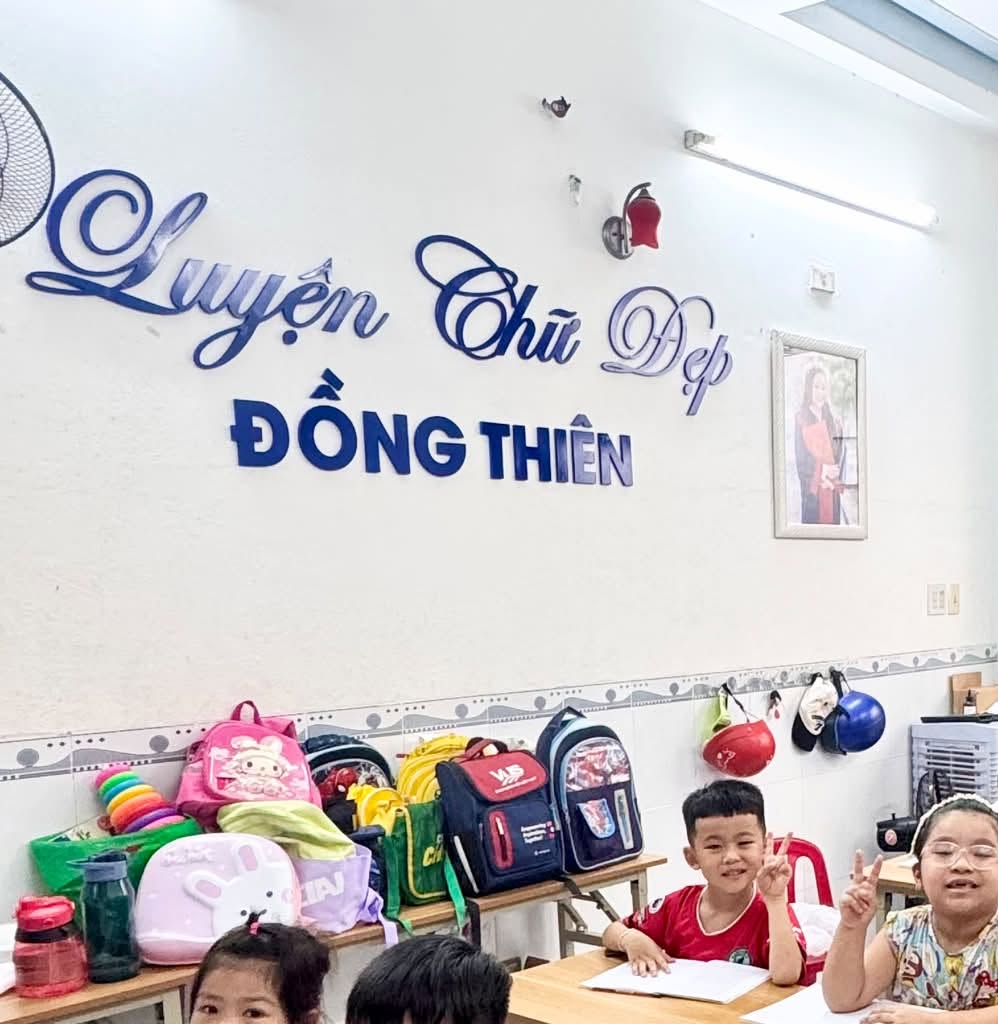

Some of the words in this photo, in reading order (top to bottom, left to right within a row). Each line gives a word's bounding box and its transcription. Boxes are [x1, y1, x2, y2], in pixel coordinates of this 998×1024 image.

[25, 169, 389, 369] Luyện
[415, 235, 581, 364] Chữ
[600, 286, 733, 416] Đẹp
[230, 367, 467, 477] ĐỒNG
[479, 414, 633, 487] THIÊN
